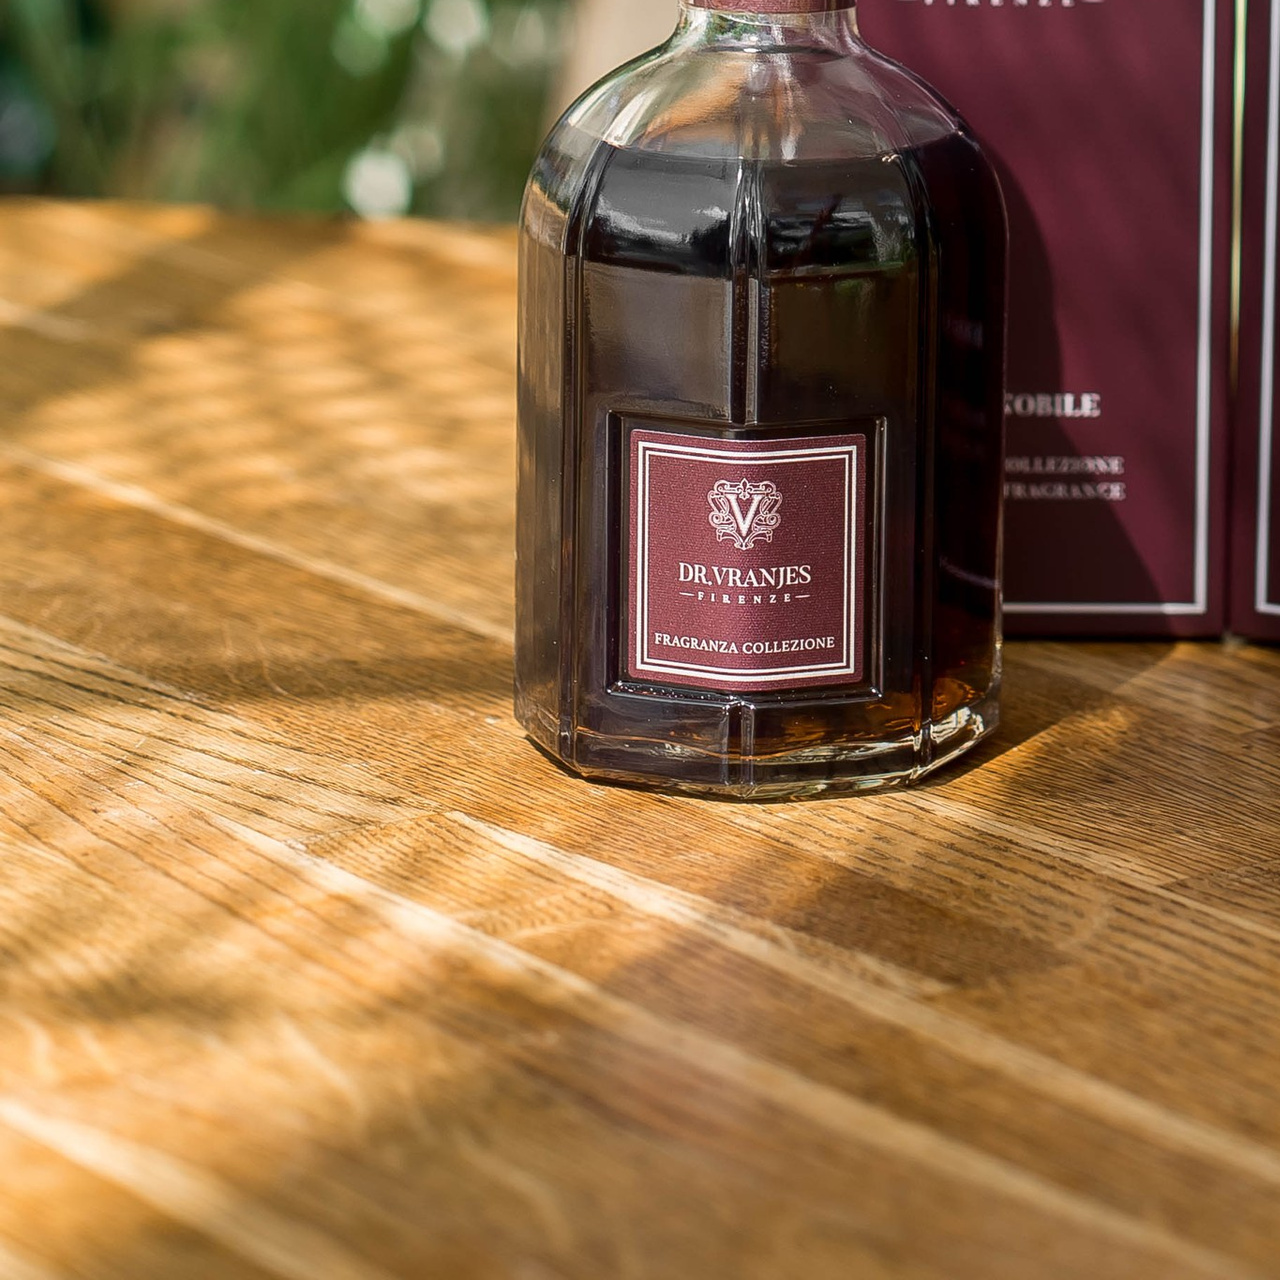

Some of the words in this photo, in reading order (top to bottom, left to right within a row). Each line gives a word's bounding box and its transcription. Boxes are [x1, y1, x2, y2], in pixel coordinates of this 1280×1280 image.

[1003, 456, 1125, 475] OLLEZIONE
[678, 562, 812, 590] DR.VRANJES
[697, 591, 792, 605] FIRENZE
[654, 632, 739, 654] FRAGRANZA
[742, 636, 836, 655] COLLEZIONE
